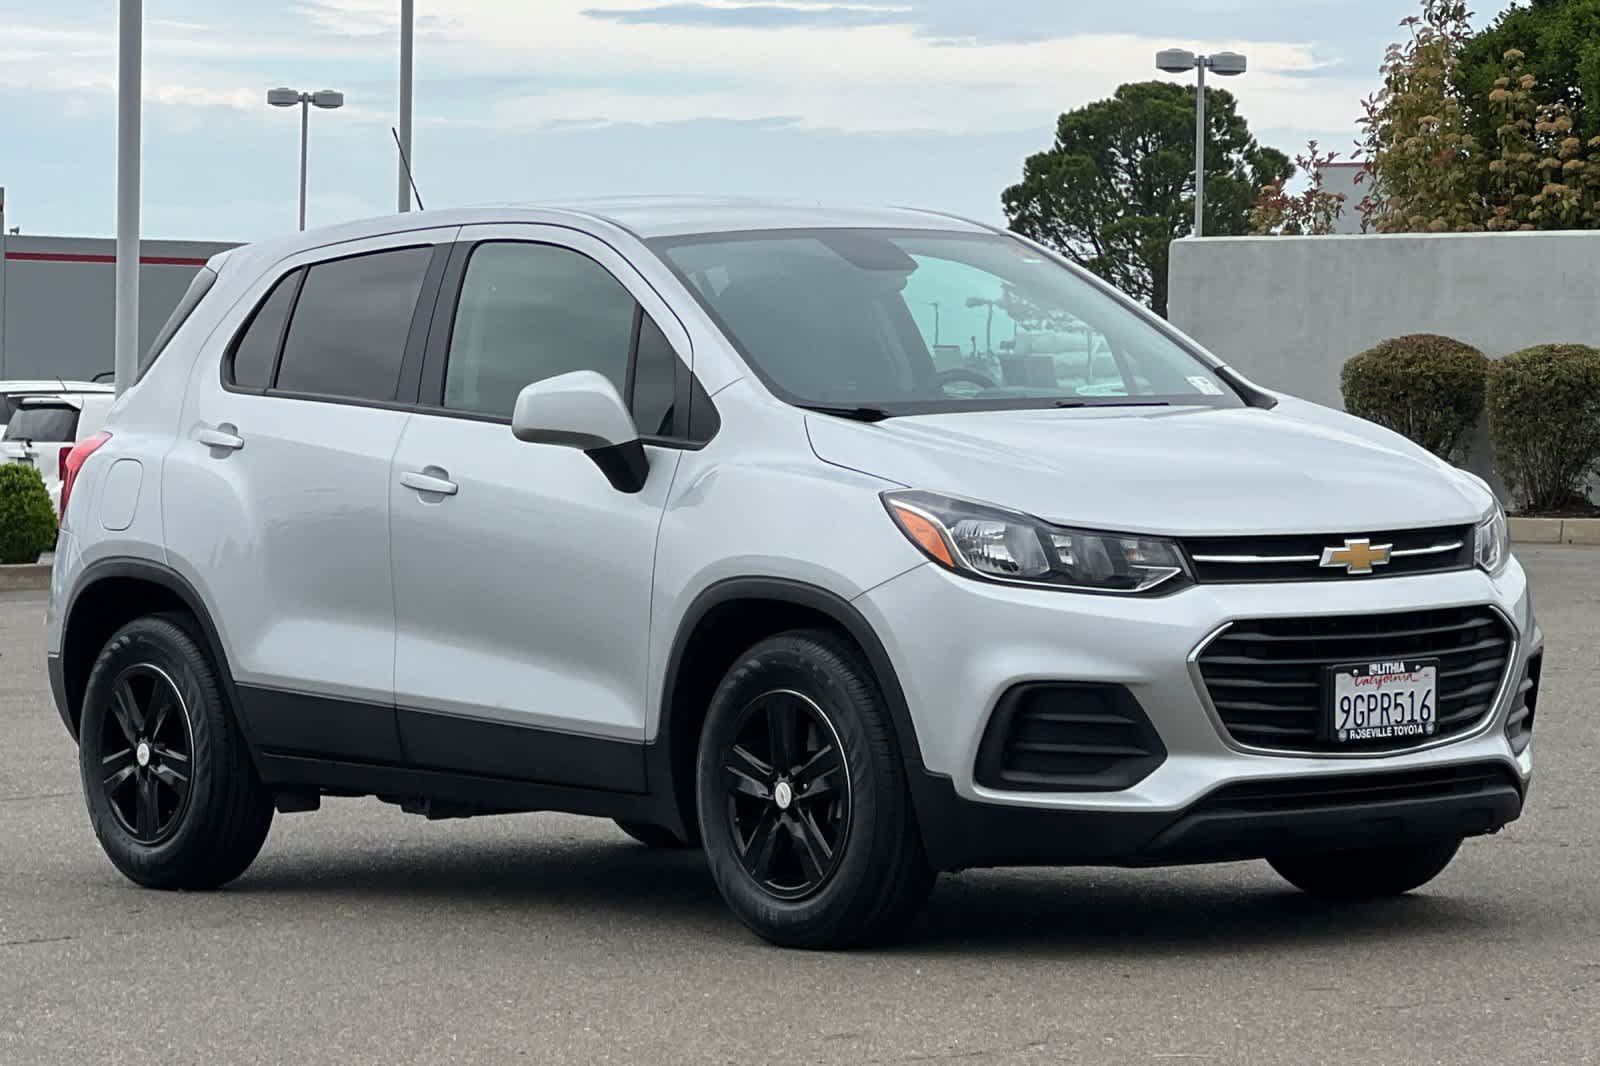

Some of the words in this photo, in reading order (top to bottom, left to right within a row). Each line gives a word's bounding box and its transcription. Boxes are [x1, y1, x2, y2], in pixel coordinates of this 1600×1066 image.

[1377, 661, 1405, 674] LITHIA
[1354, 672, 1419, 690] California
[1340, 689, 1432, 729] 9GPR516
[1350, 726, 1393, 740] ROSEVILLE
[1393, 724, 1424, 736] TOYOTA
